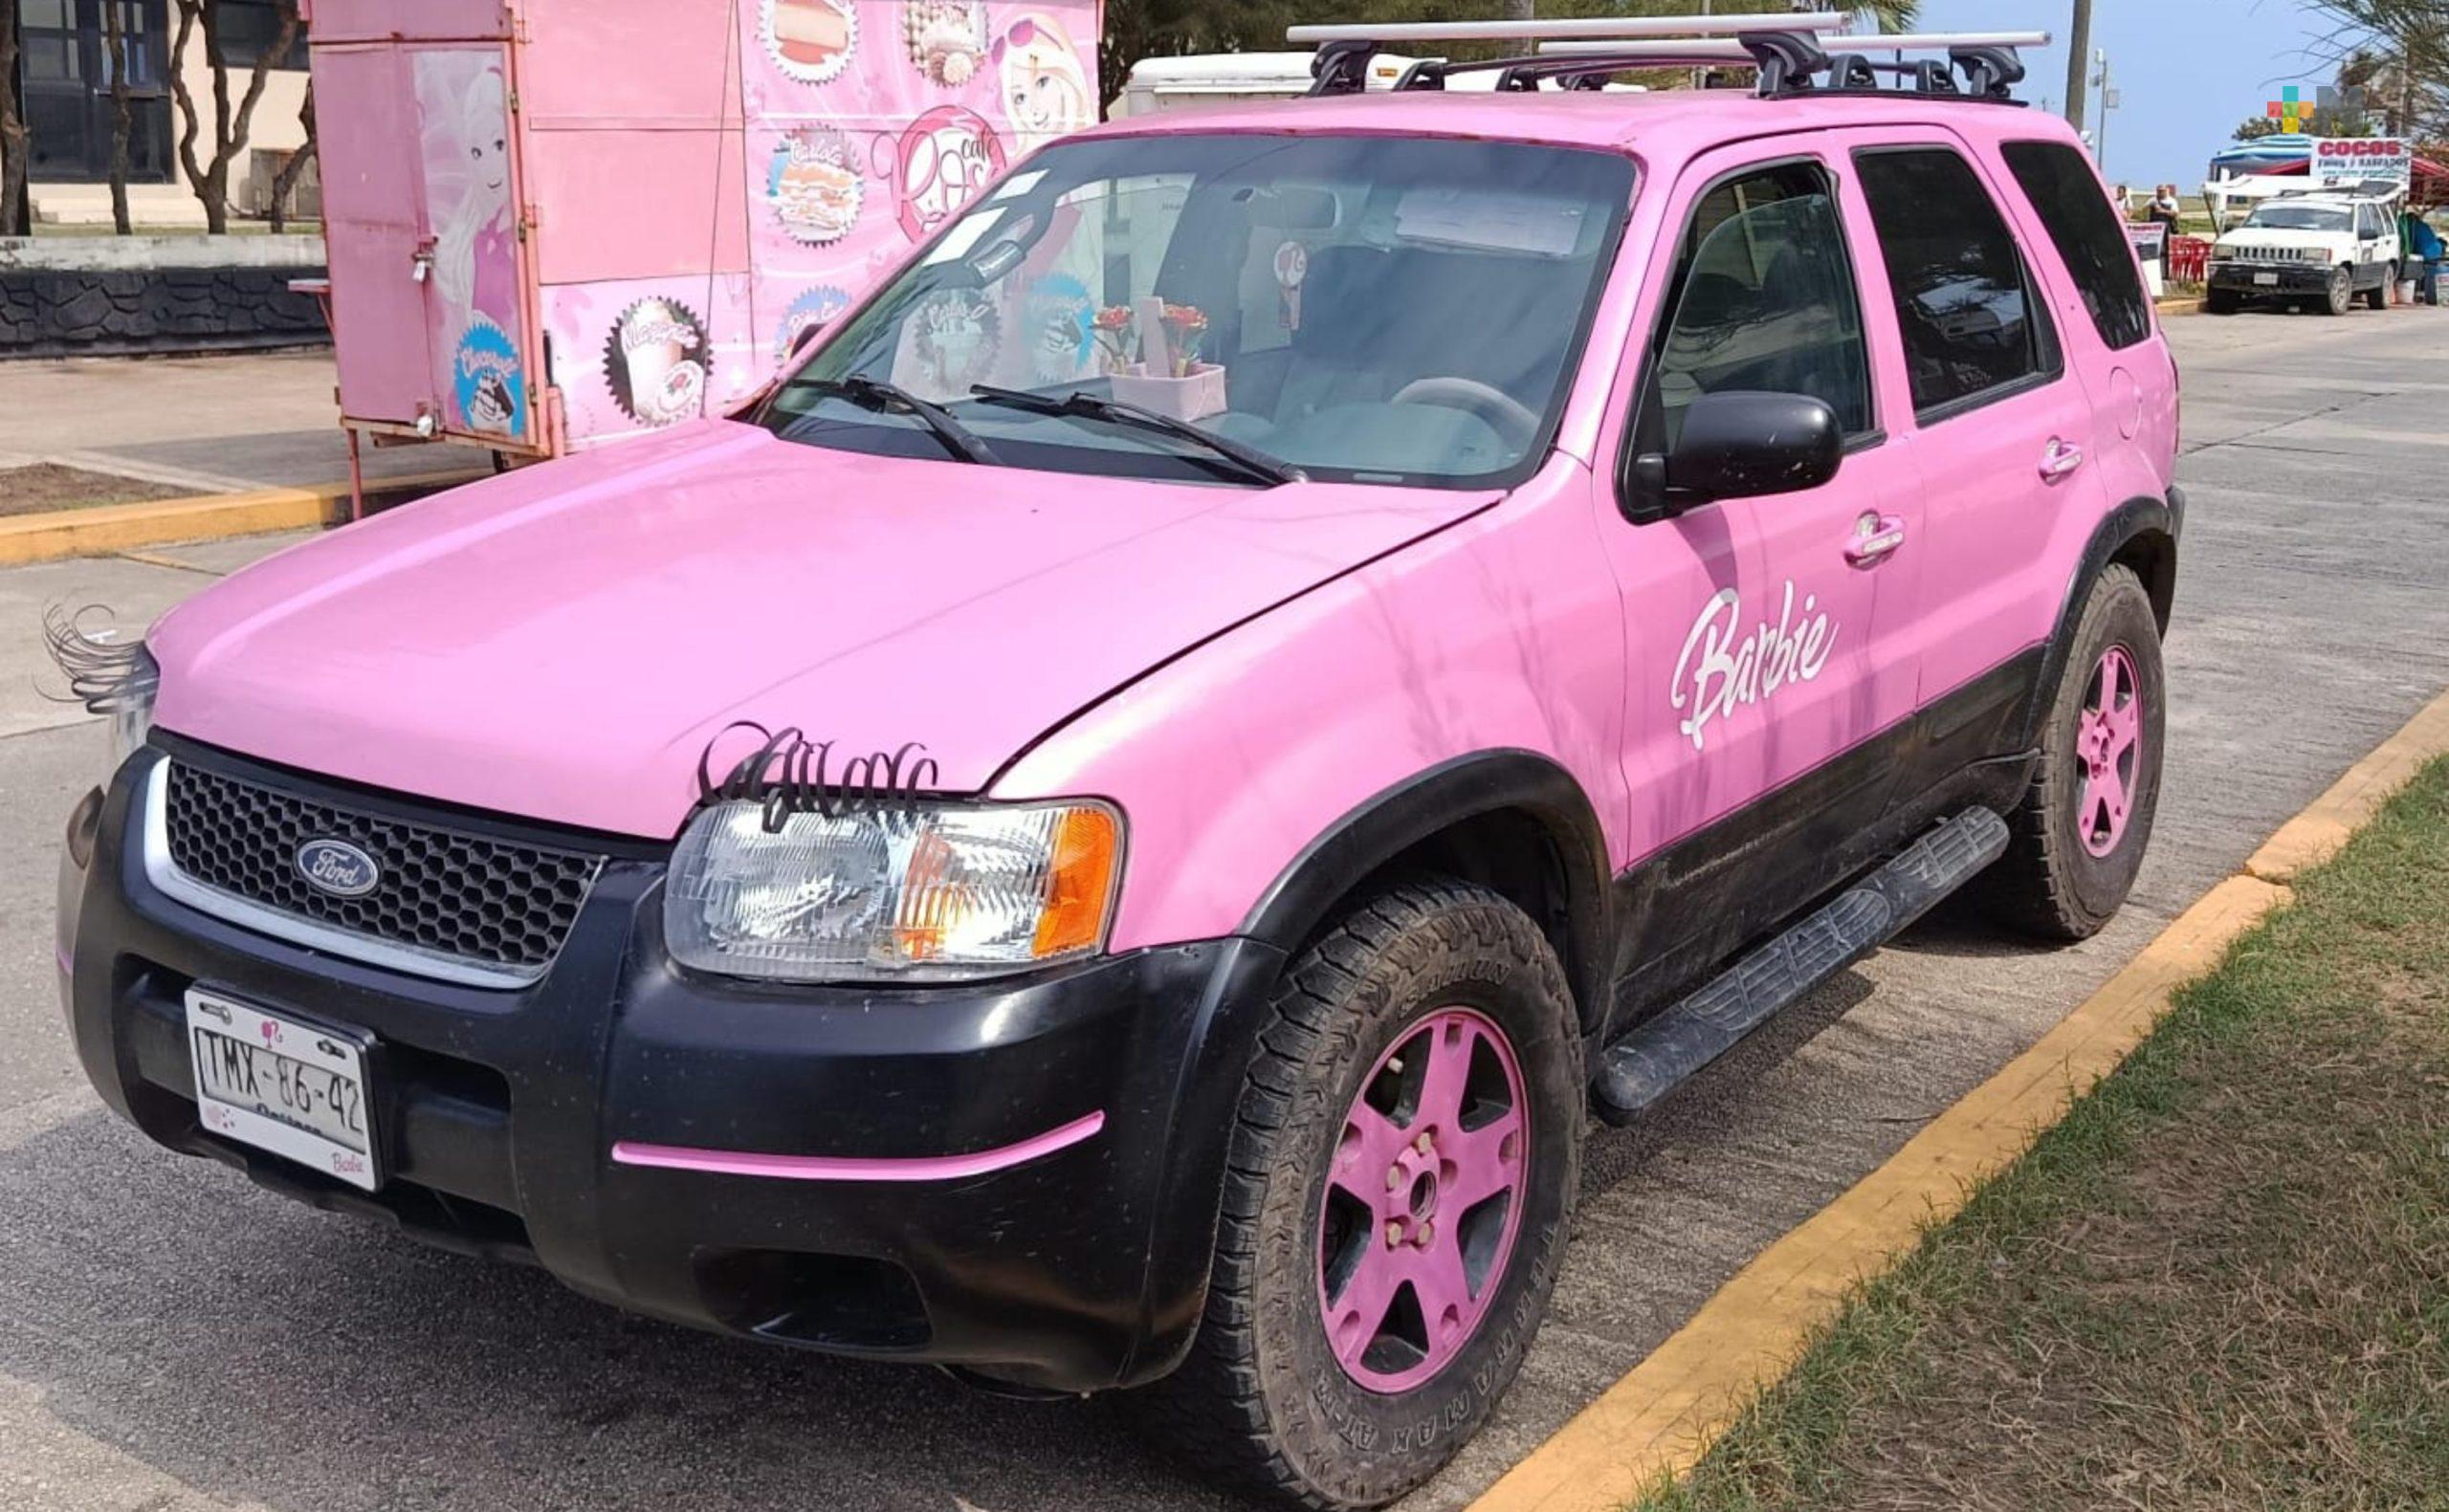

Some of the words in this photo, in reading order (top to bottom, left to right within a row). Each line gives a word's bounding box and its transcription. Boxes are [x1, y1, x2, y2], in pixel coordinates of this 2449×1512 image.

[2318, 141, 2400, 156] COCOS
[1671, 580, 1840, 750] Barbie
[313, 848, 360, 886] Ford
[203, 1030, 364, 1133] TMX-86-42
[331, 1150, 364, 1172] Barbie
